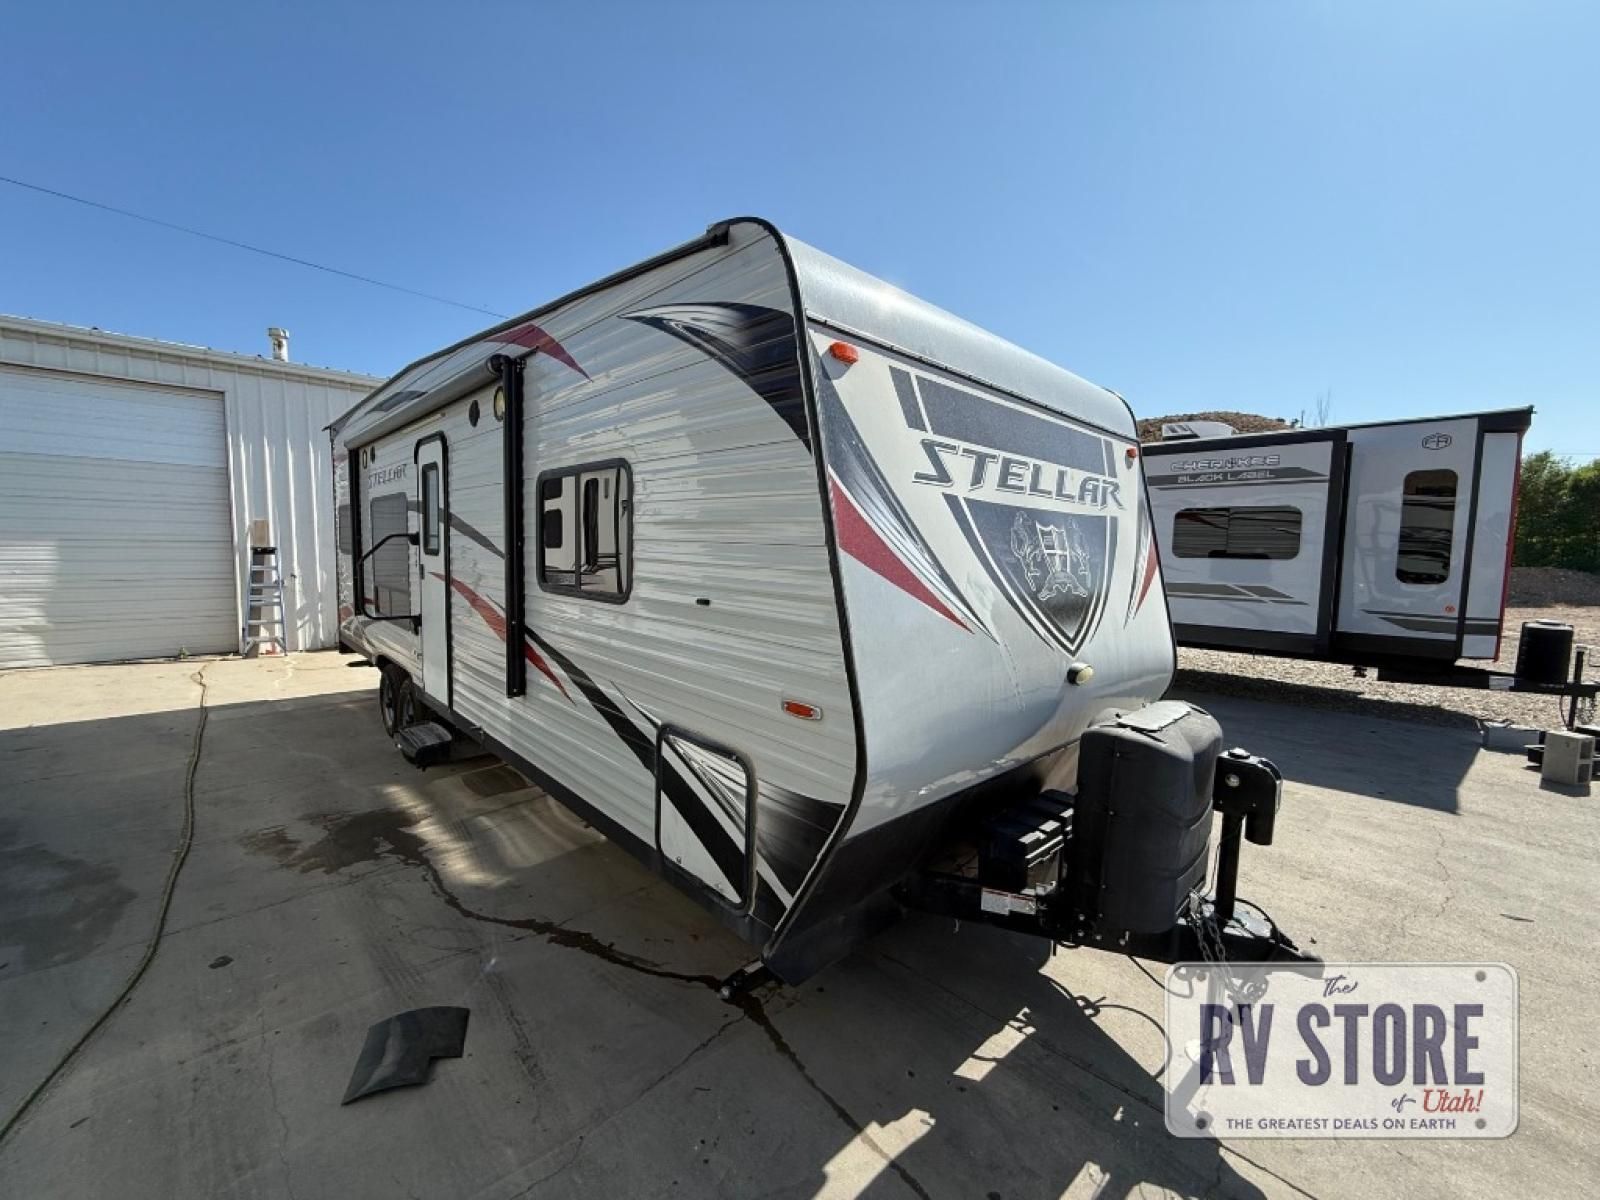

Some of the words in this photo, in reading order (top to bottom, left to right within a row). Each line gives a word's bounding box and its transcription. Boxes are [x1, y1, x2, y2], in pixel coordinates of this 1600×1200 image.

[368, 463, 407, 489] STELLAR
[912, 438, 1126, 511] STELLAR
[1178, 472, 1223, 483] BLACK
[1228, 470, 1276, 481] LABEL
